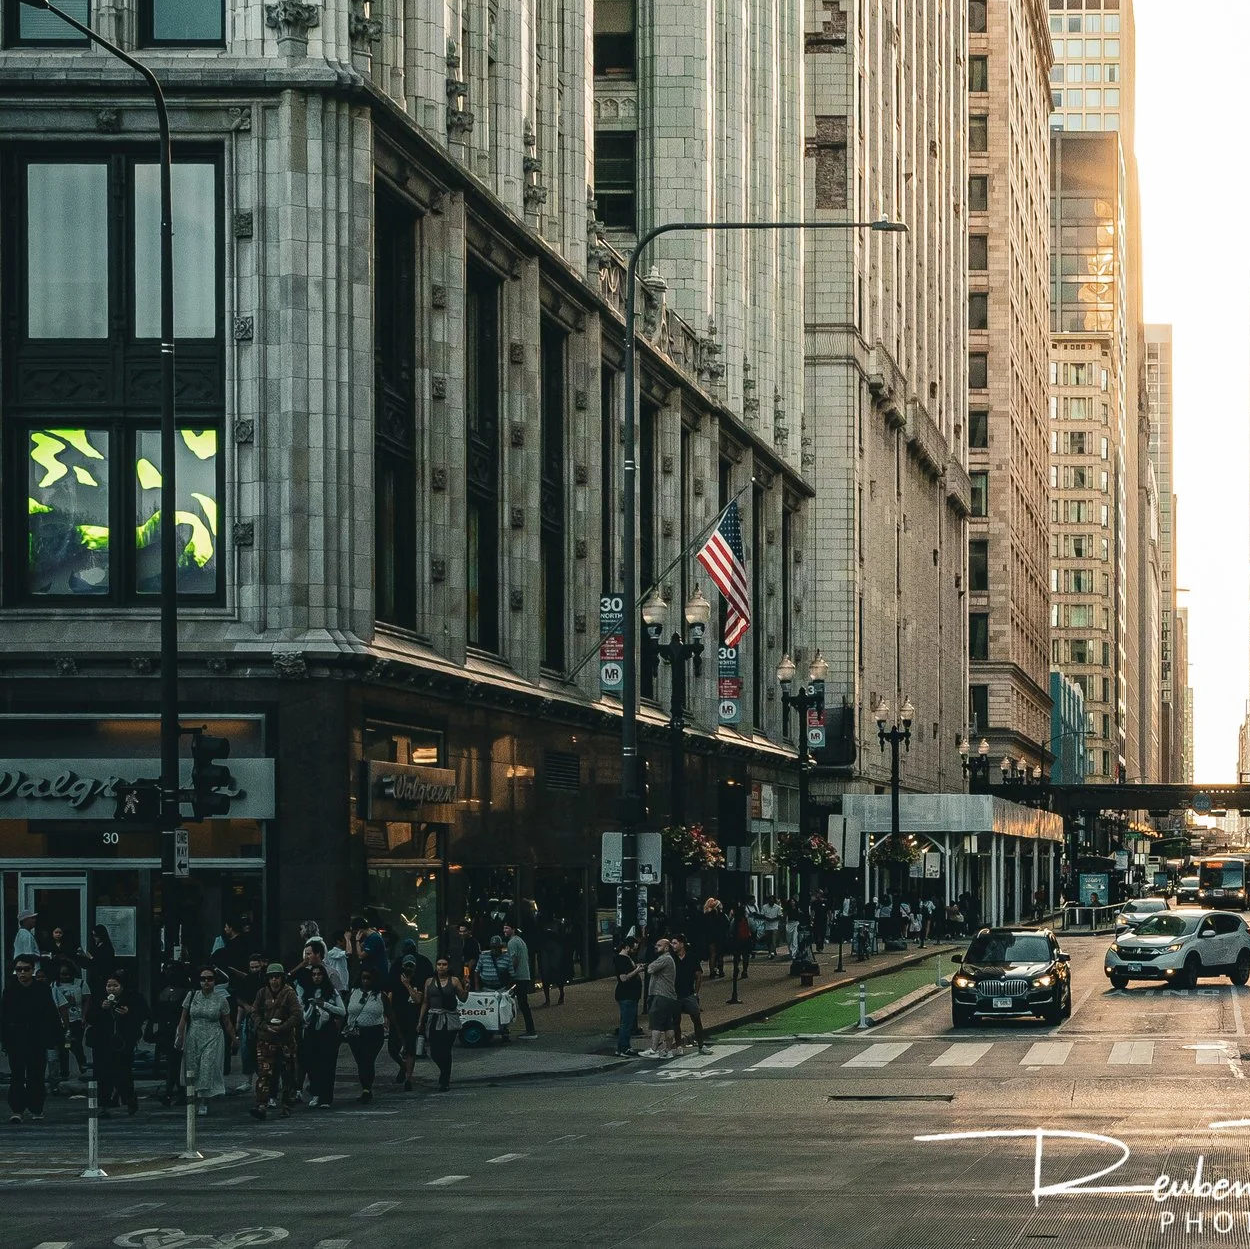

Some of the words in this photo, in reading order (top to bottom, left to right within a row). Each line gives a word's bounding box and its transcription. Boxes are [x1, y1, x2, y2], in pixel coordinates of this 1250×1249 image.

[600, 597, 623, 612] 30
[718, 647, 736, 659] 30
[605, 668, 619, 679] MR
[103, 832, 119, 844] 30
[177, 833, 188, 845] ONE
[177, 846, 188, 857] WAY
[460, 1008, 487, 1016] teca
